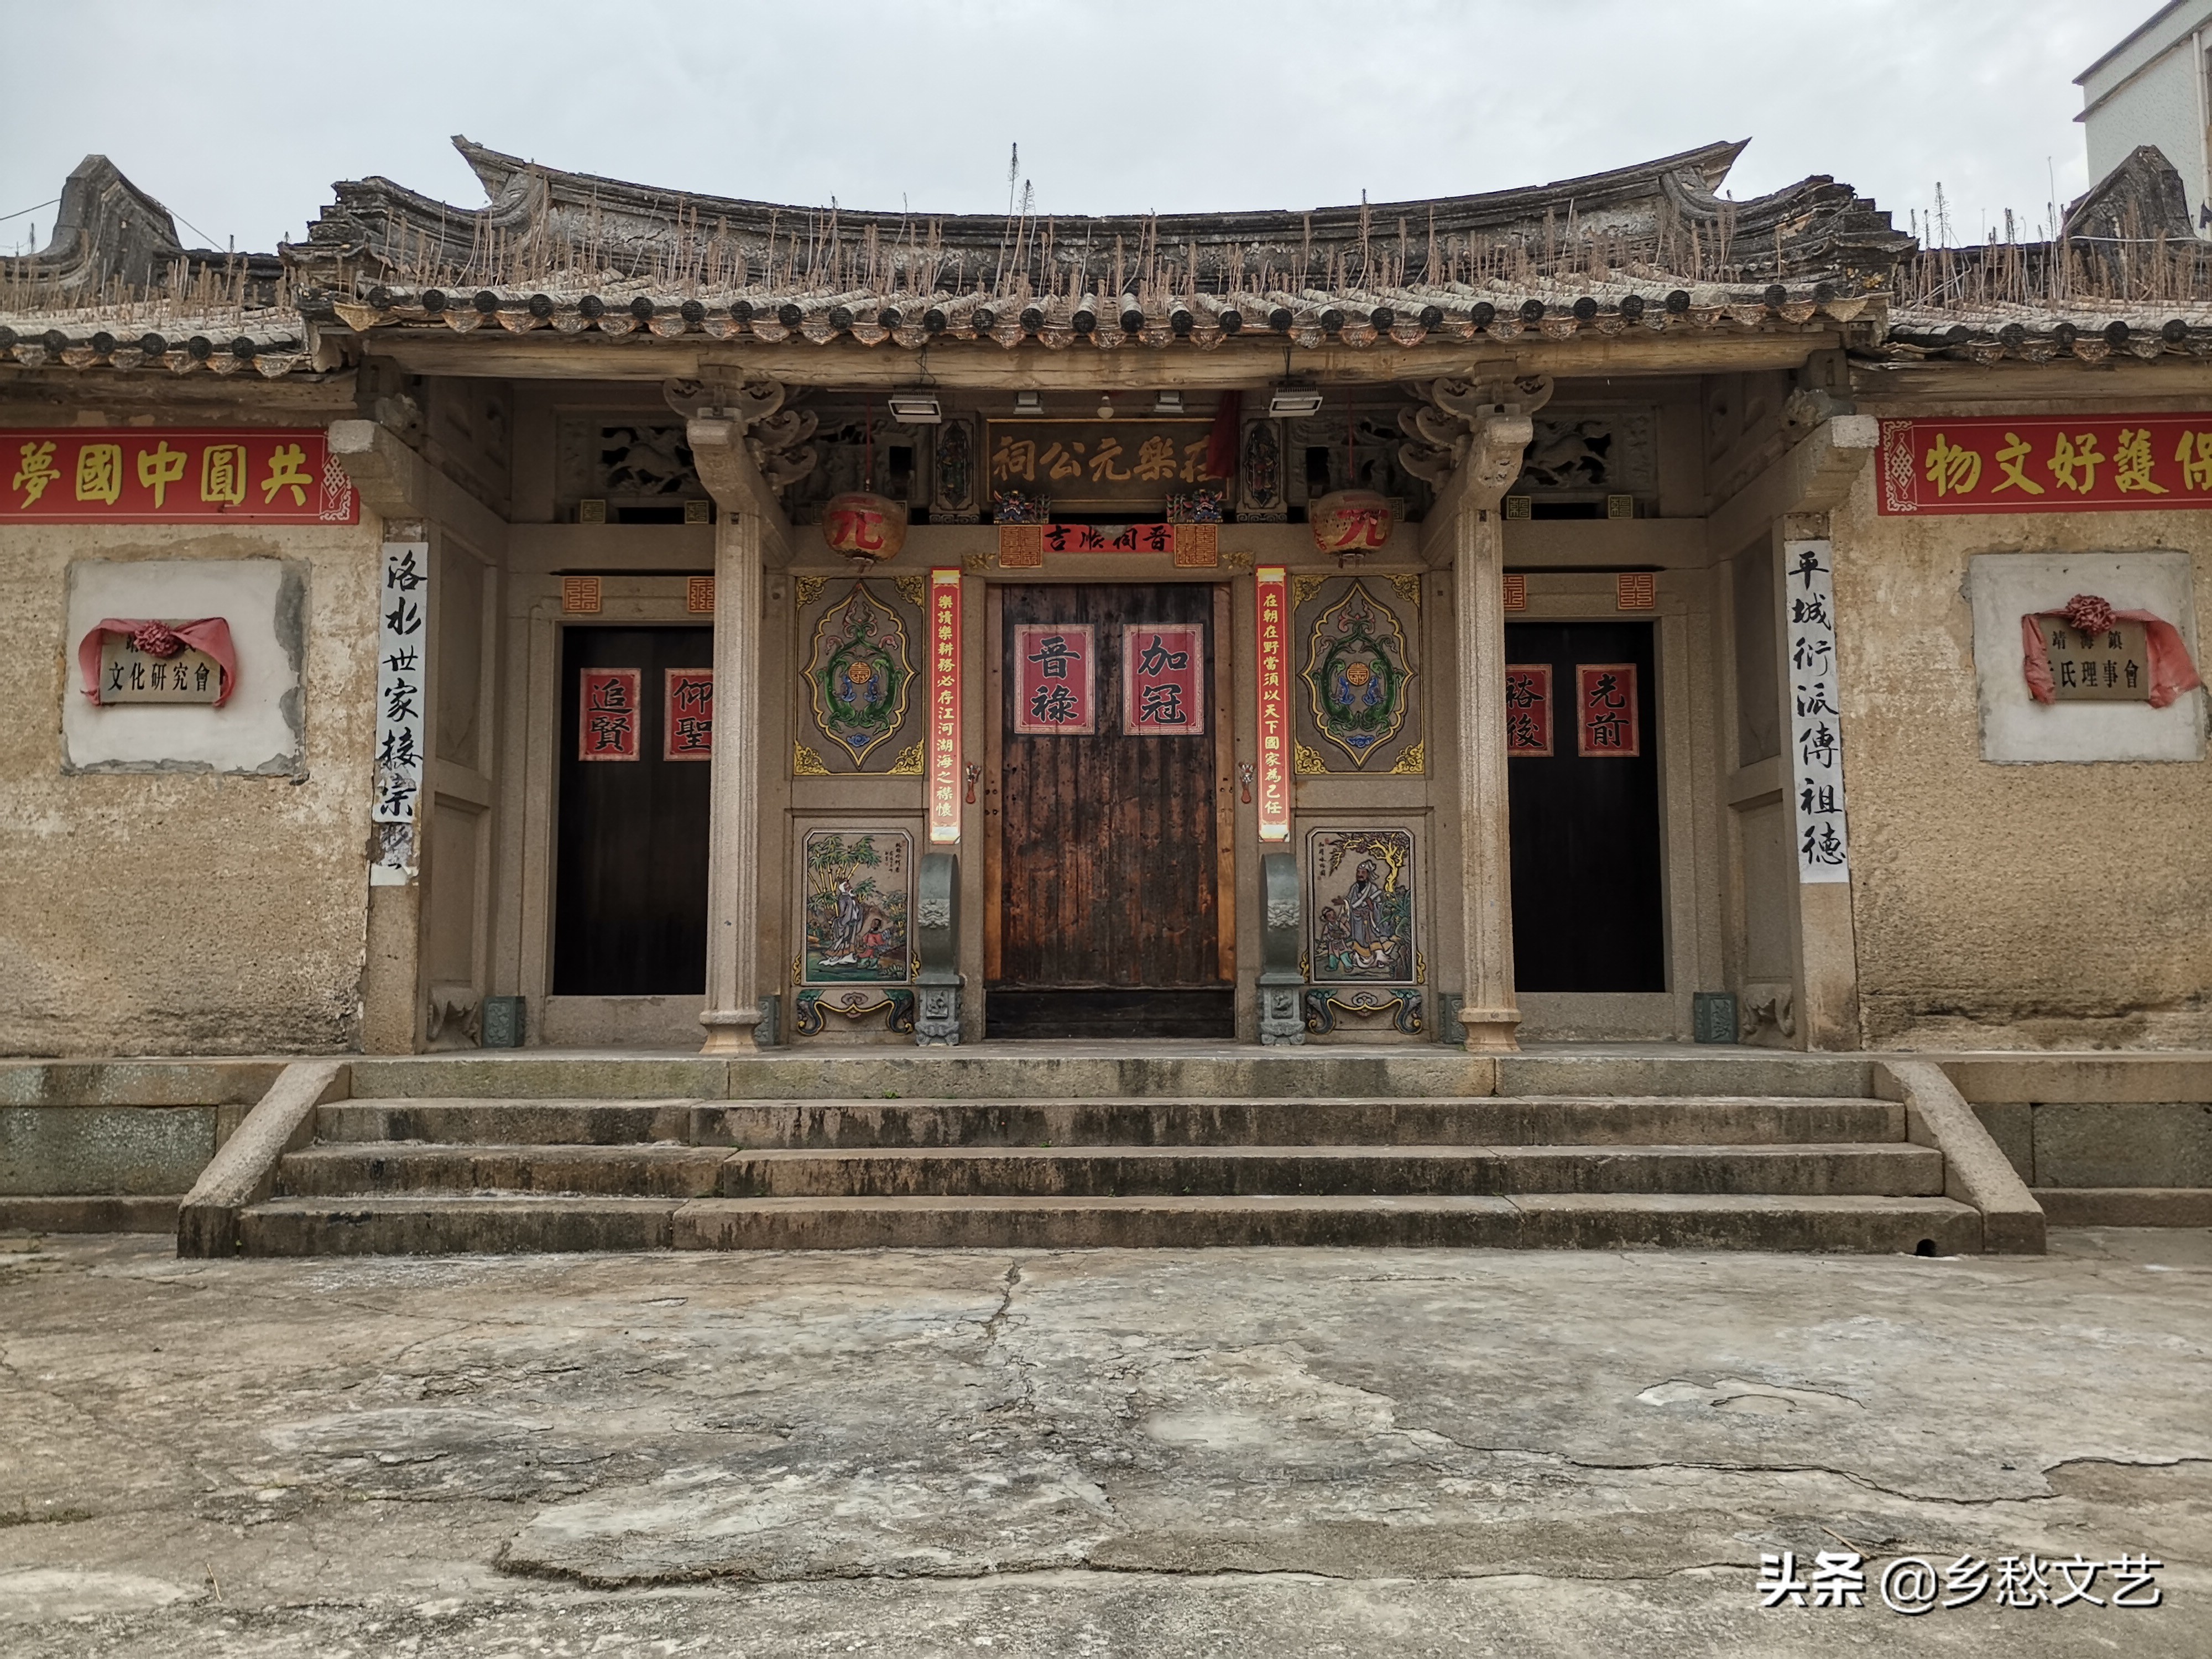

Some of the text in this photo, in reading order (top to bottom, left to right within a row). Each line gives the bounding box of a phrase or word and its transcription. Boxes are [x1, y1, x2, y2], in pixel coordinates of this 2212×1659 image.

[12, 440, 314, 509] 共圓中國夢
[108, 661, 210, 692] 文化研究會
[379, 549, 427, 870] 洛水世家接宗
[1137, 634, 1190, 724] 加冠
[1585, 672, 1630, 747] 光前
[2047, 659, 2139, 688] 氏理事會
[588, 677, 634, 752] 追賢
